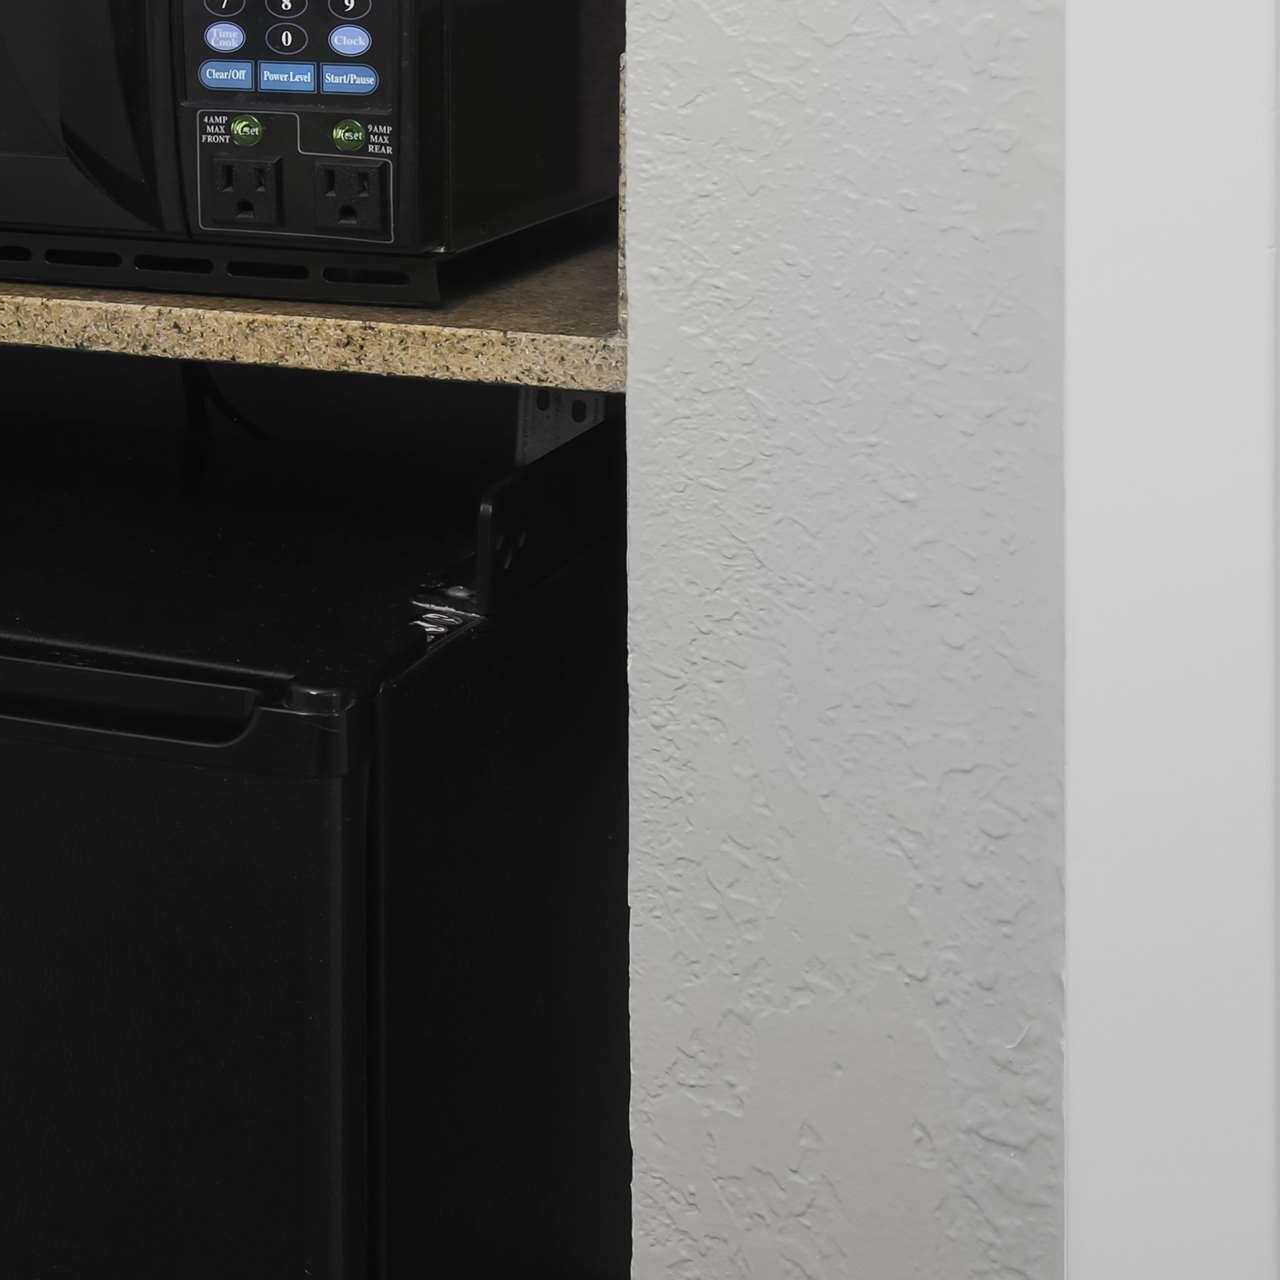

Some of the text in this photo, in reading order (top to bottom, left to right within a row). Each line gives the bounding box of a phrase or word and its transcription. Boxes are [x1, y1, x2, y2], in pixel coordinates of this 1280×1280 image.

[281, 30, 292, 47] 0
[334, 35, 365, 47] Clock
[206, 69, 247, 81] Clear/Off
[263, 71, 311, 83] Power Level
[325, 72, 375, 86] Start/Pause
[206, 124, 225, 134] MAX
[201, 134, 230, 143] FRONT
[370, 134, 390, 144] MAX
[368, 144, 393, 155] REAR
